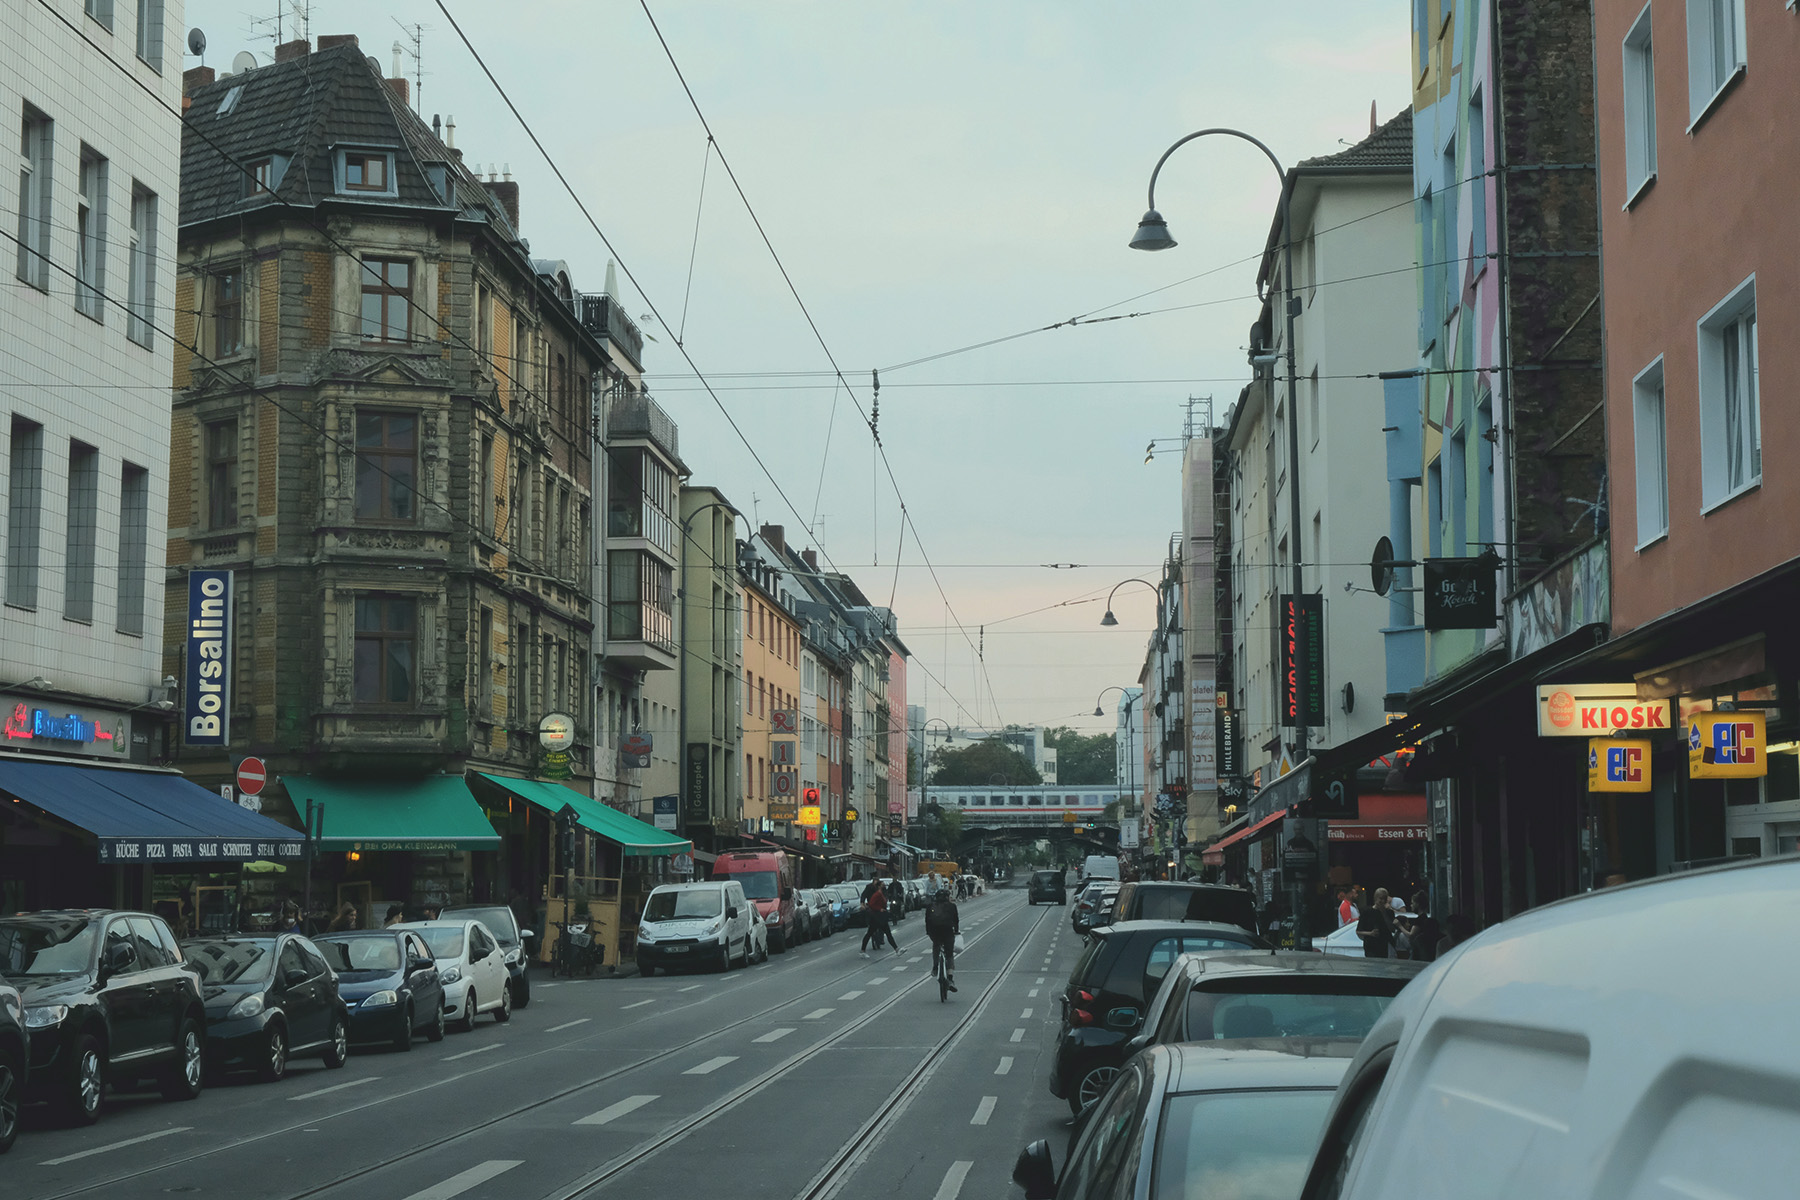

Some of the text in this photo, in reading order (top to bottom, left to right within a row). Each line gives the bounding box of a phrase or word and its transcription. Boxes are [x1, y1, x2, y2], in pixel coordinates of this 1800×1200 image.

[1309, 610, 1318, 662] RESTAURANT
[190, 577, 224, 737] Borsalino
[1310, 669, 1318, 685] BAR
[1581, 706, 1665, 729] KIOSK
[1224, 715, 1232, 770] HILLEBRAND
[694, 762, 704, 807] Goldapfel
[1224, 787, 1242, 798] sky
[1378, 829, 1404, 838] Essen
[1407, 828, 1415, 838] &
[115, 840, 302, 858] KÜCHE PIZZA PASTA SALAT SCHNITZEL STEAK COCKTAIL
[381, 842, 402, 850] OMA
[404, 842, 457, 850] KLEINMANN
